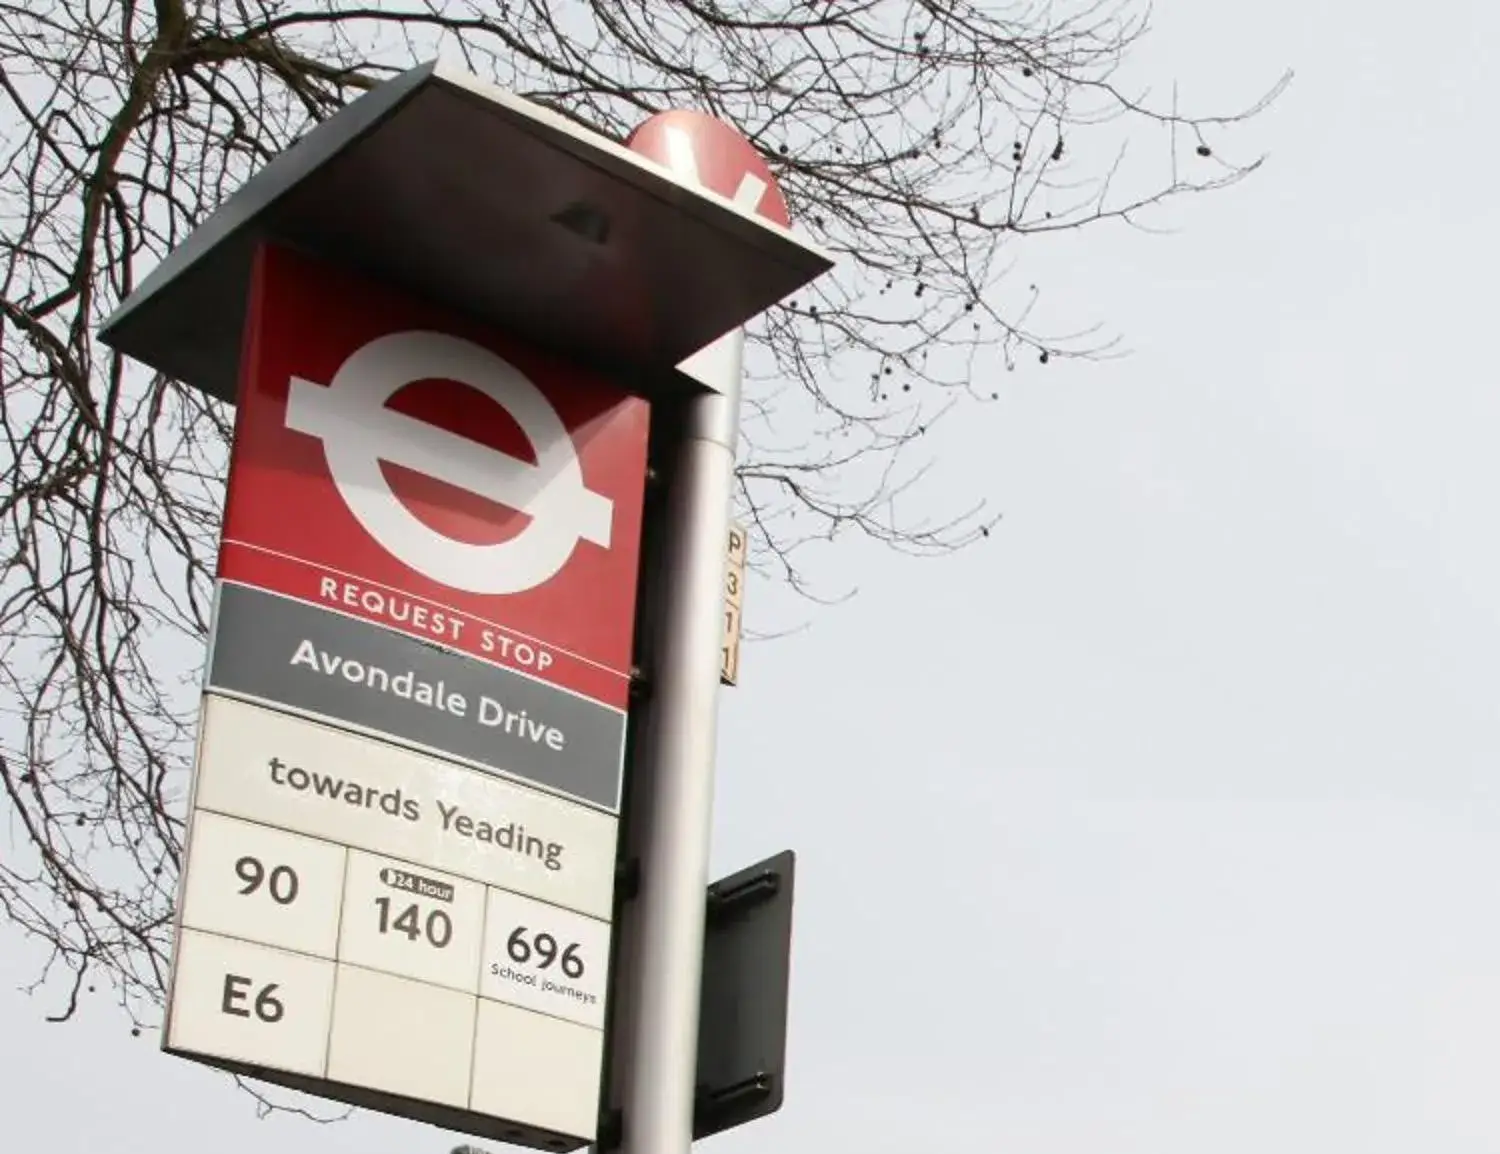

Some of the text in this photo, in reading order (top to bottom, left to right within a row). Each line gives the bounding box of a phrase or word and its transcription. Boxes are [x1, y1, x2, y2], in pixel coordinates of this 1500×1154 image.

[320, 576, 554, 671] REQUEST STOP
[721, 530, 742, 669] P311
[290, 638, 566, 752] Avondale Drive
[268, 756, 563, 871] towards Yeading
[234, 855, 299, 906] 90
[396, 872, 452, 900] 24 hour
[375, 897, 453, 949] 140
[507, 926, 585, 979] 696
[221, 973, 285, 1024] E6
[490, 962, 597, 1004] School journeys
